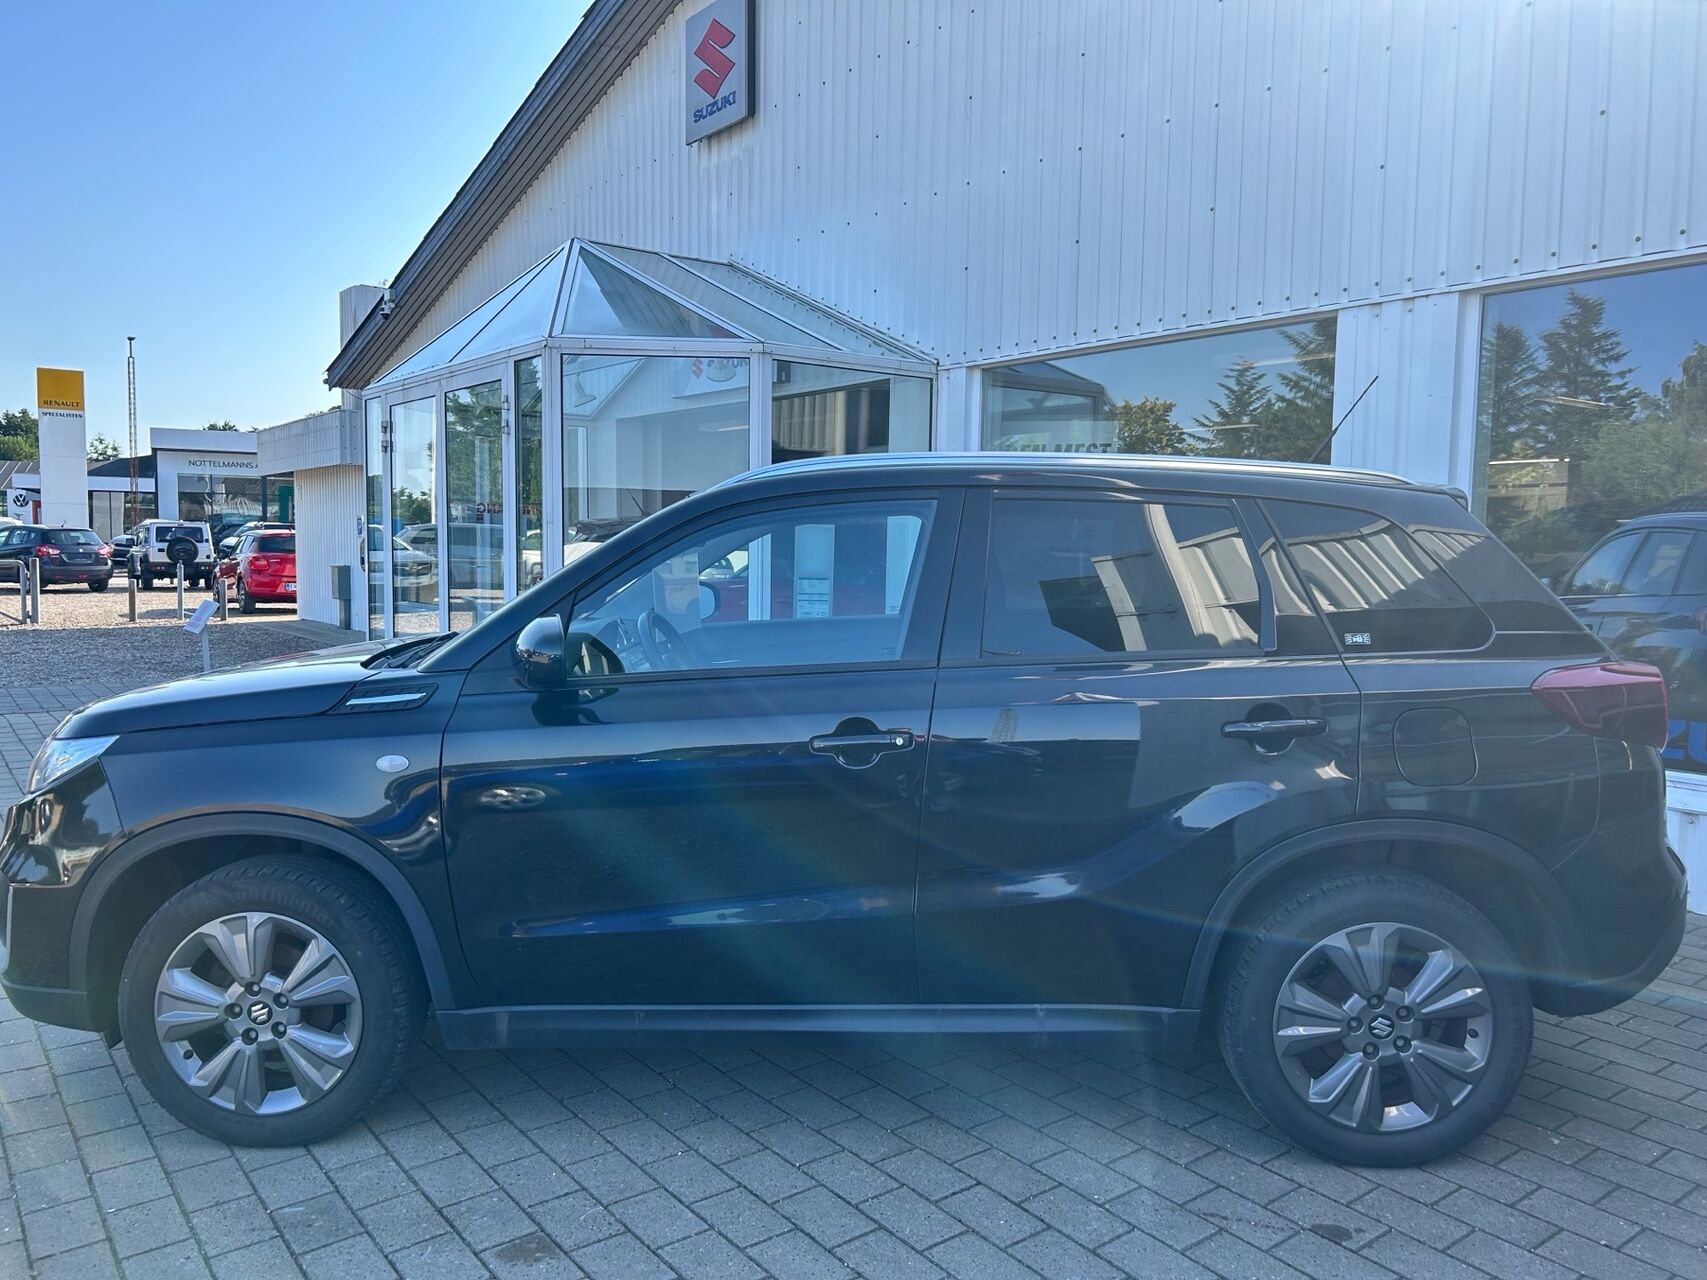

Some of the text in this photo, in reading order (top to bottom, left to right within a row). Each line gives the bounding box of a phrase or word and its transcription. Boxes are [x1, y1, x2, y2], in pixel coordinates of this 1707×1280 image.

[693, 90, 736, 123] SUZUKI
[43, 399, 80, 408] RENAULT
[188, 459, 254, 469] NOTTELMANNS
